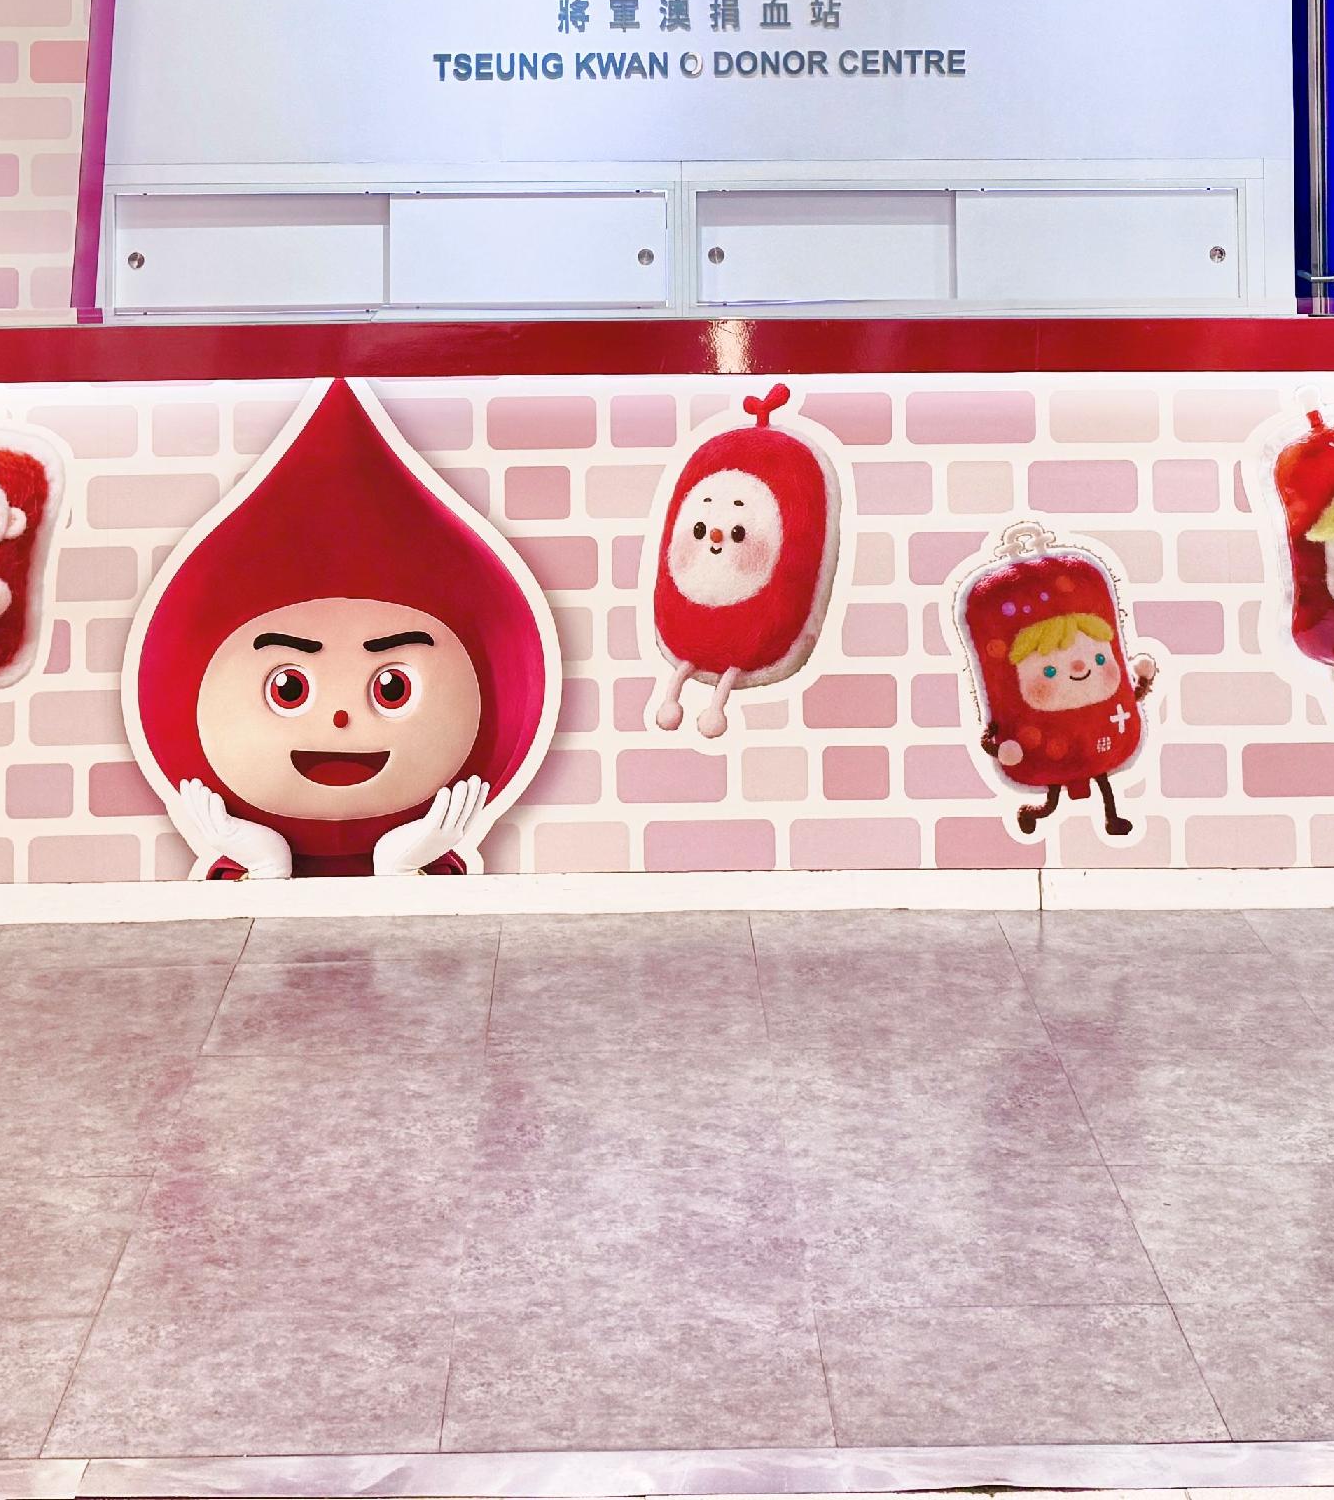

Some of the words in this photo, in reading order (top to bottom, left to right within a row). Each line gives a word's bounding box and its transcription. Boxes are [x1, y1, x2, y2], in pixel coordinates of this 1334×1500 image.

[432, 52, 564, 82] TSEUNG
[575, 51, 669, 80] KWAN
[679, 51, 703, 79] O
[713, 49, 829, 77] DONOR
[838, 49, 966, 77] CENTRE
